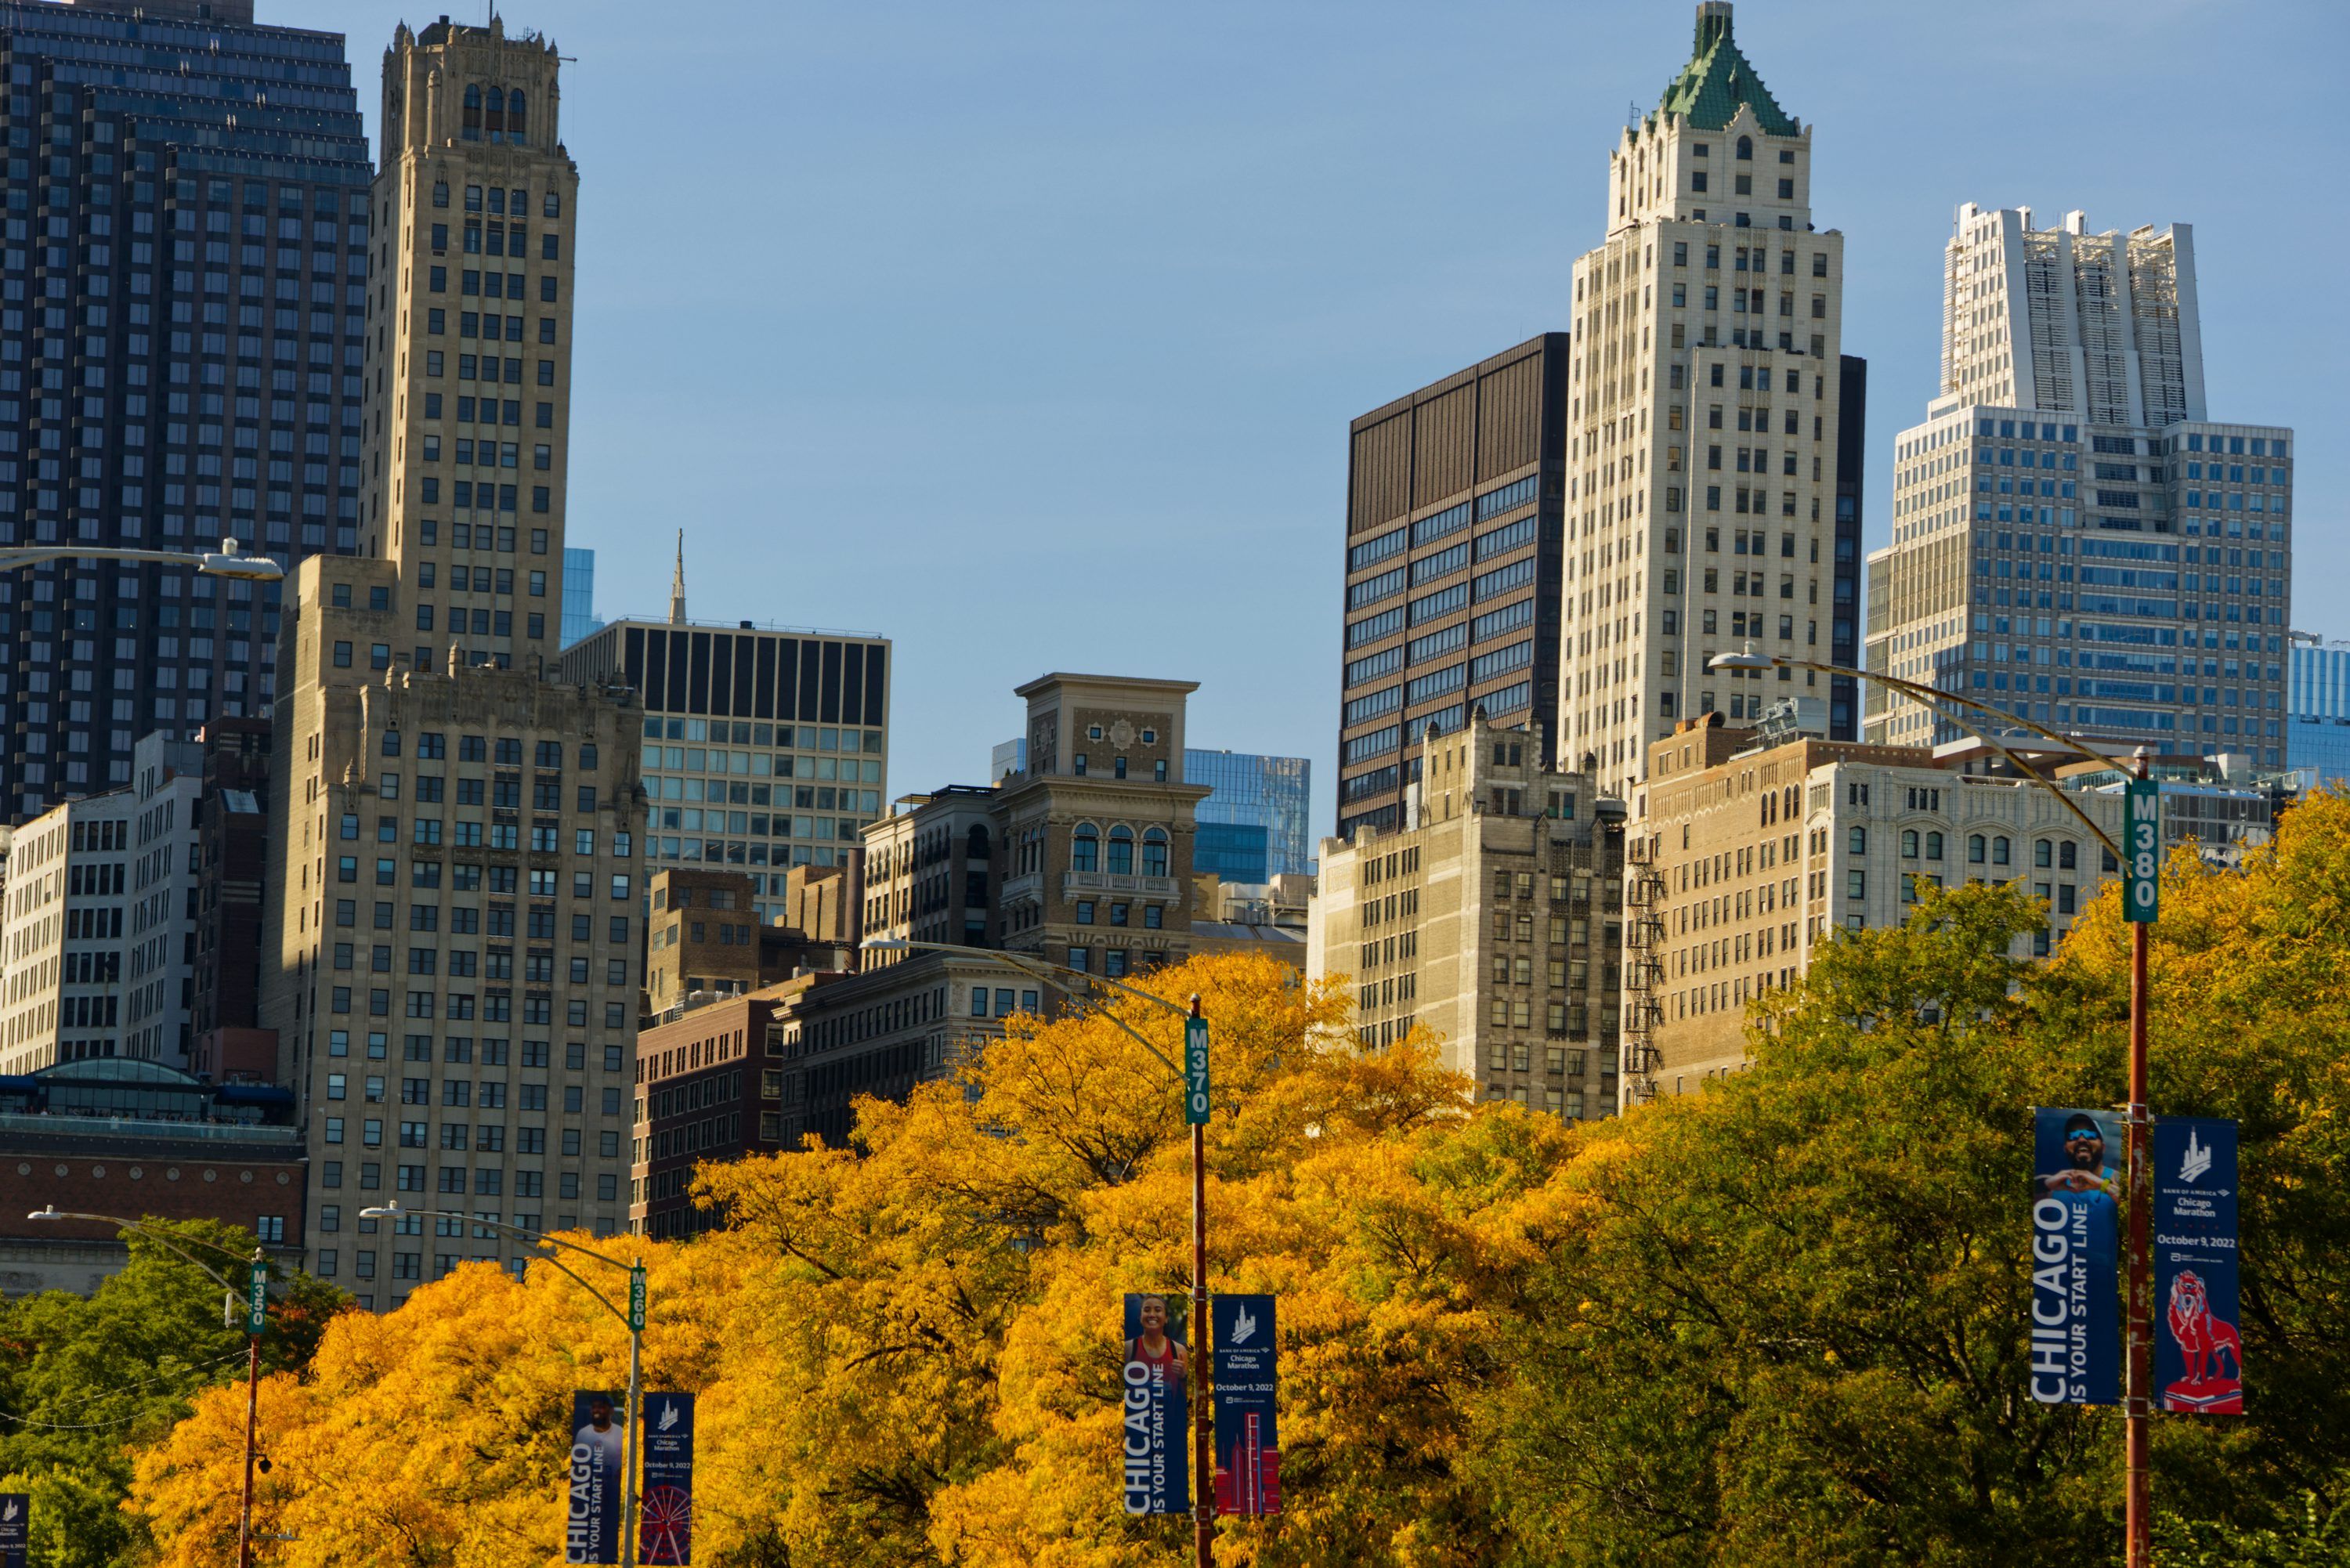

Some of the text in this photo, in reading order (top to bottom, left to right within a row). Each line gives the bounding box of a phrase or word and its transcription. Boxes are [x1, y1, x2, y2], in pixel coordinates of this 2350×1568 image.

[2133, 794, 2157, 907] M380
[1190, 1028, 1207, 1112] M370
[2157, 1234, 2236, 1248] October 9, 2022
[2173, 1207, 2216, 1217] Marathon
[2178, 1197, 2211, 1209] Chicago
[253, 1270, 266, 1325] M350
[632, 1271, 646, 1326] M360
[2030, 1198, 2068, 1404] CHICAGO
[2070, 1203, 2088, 1403] IS YOUR START LINE
[1230, 1354, 1256, 1363] Chicago
[1123, 1360, 1151, 1514] CHICAGO
[1153, 1364, 1165, 1513] IS YOUR START LINE
[566, 1443, 592, 1564] CHICAGO
[588, 1446, 603, 1563] IS YOUR START LINE
